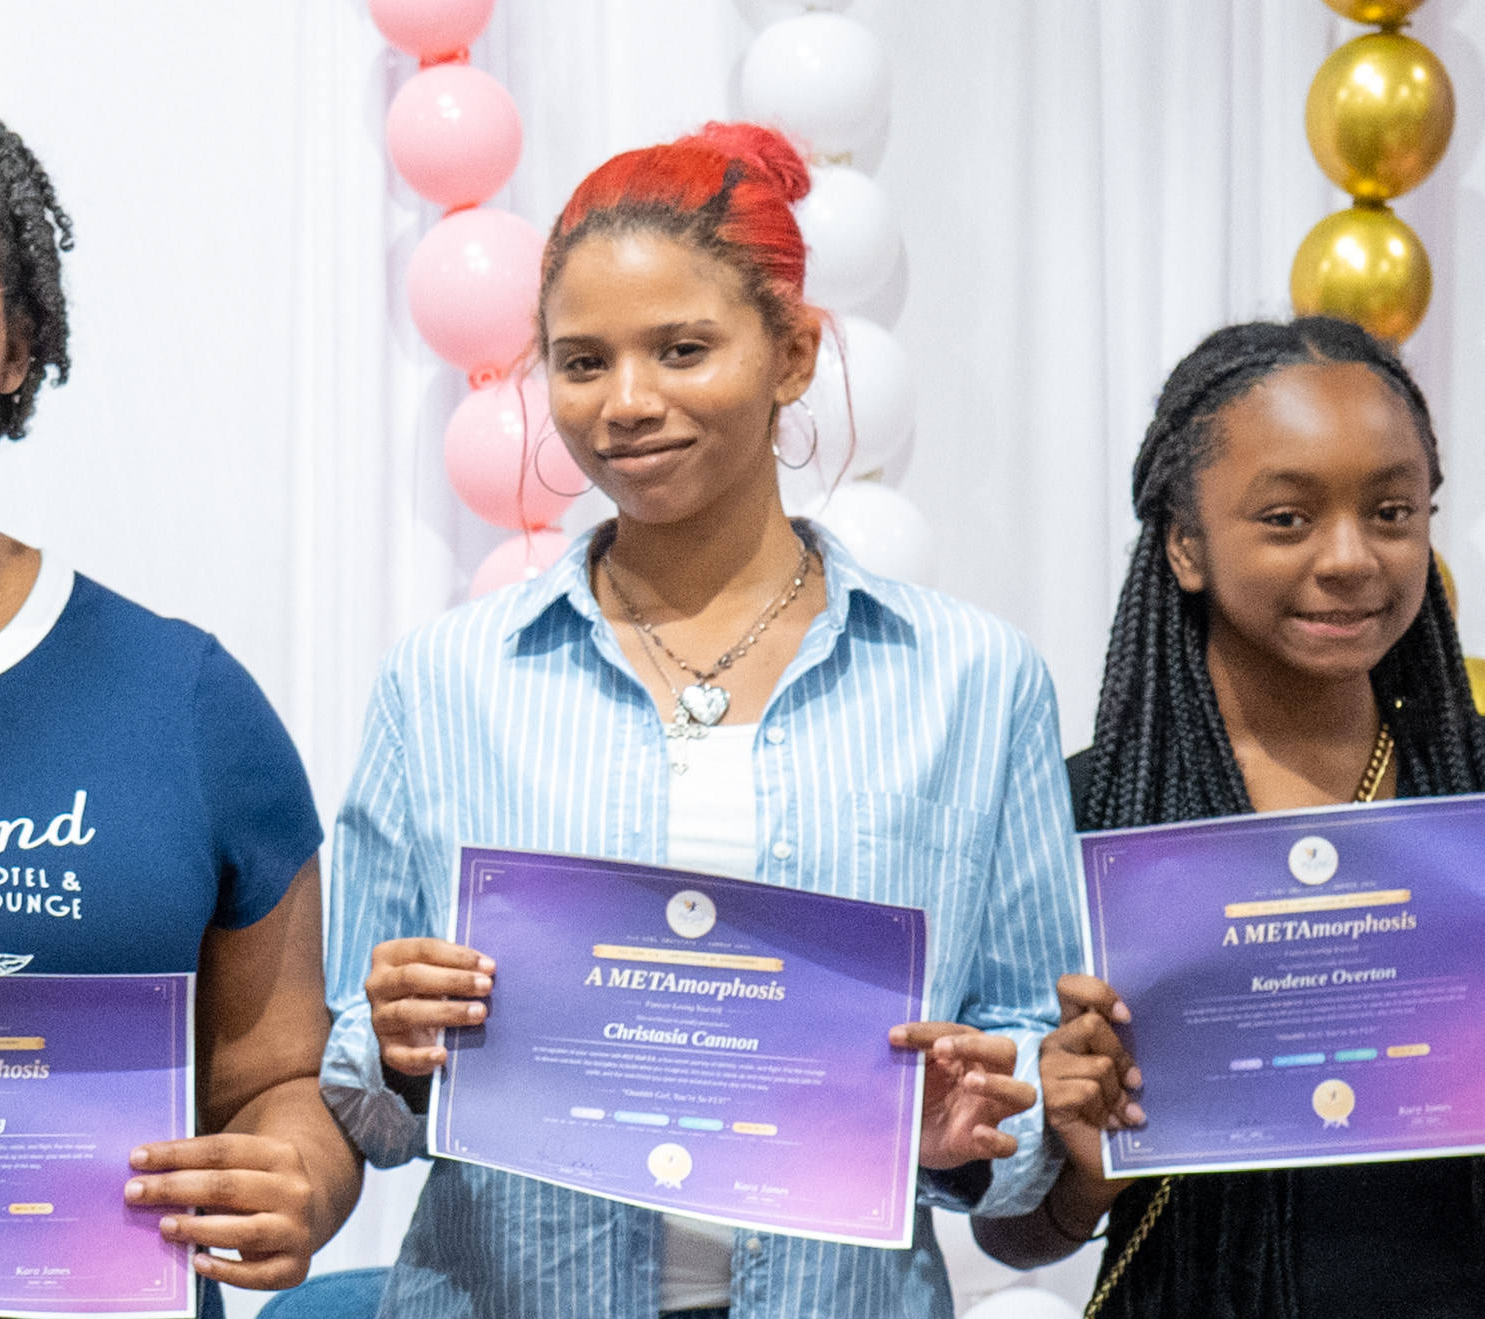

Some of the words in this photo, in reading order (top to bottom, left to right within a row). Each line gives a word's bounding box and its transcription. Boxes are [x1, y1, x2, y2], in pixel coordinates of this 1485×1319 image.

[63, 871, 82, 892] &
[1222, 926, 1240, 947] A
[1244, 911, 1417, 945] METAmorphosis
[584, 967, 603, 987] A
[608, 967, 786, 1002] METAmorphosis
[1251, 973, 1327, 995] Kaydence
[1332, 965, 1396, 986] Overton
[604, 1022, 688, 1045] Christasia
[692, 1030, 759, 1051] Cannon
